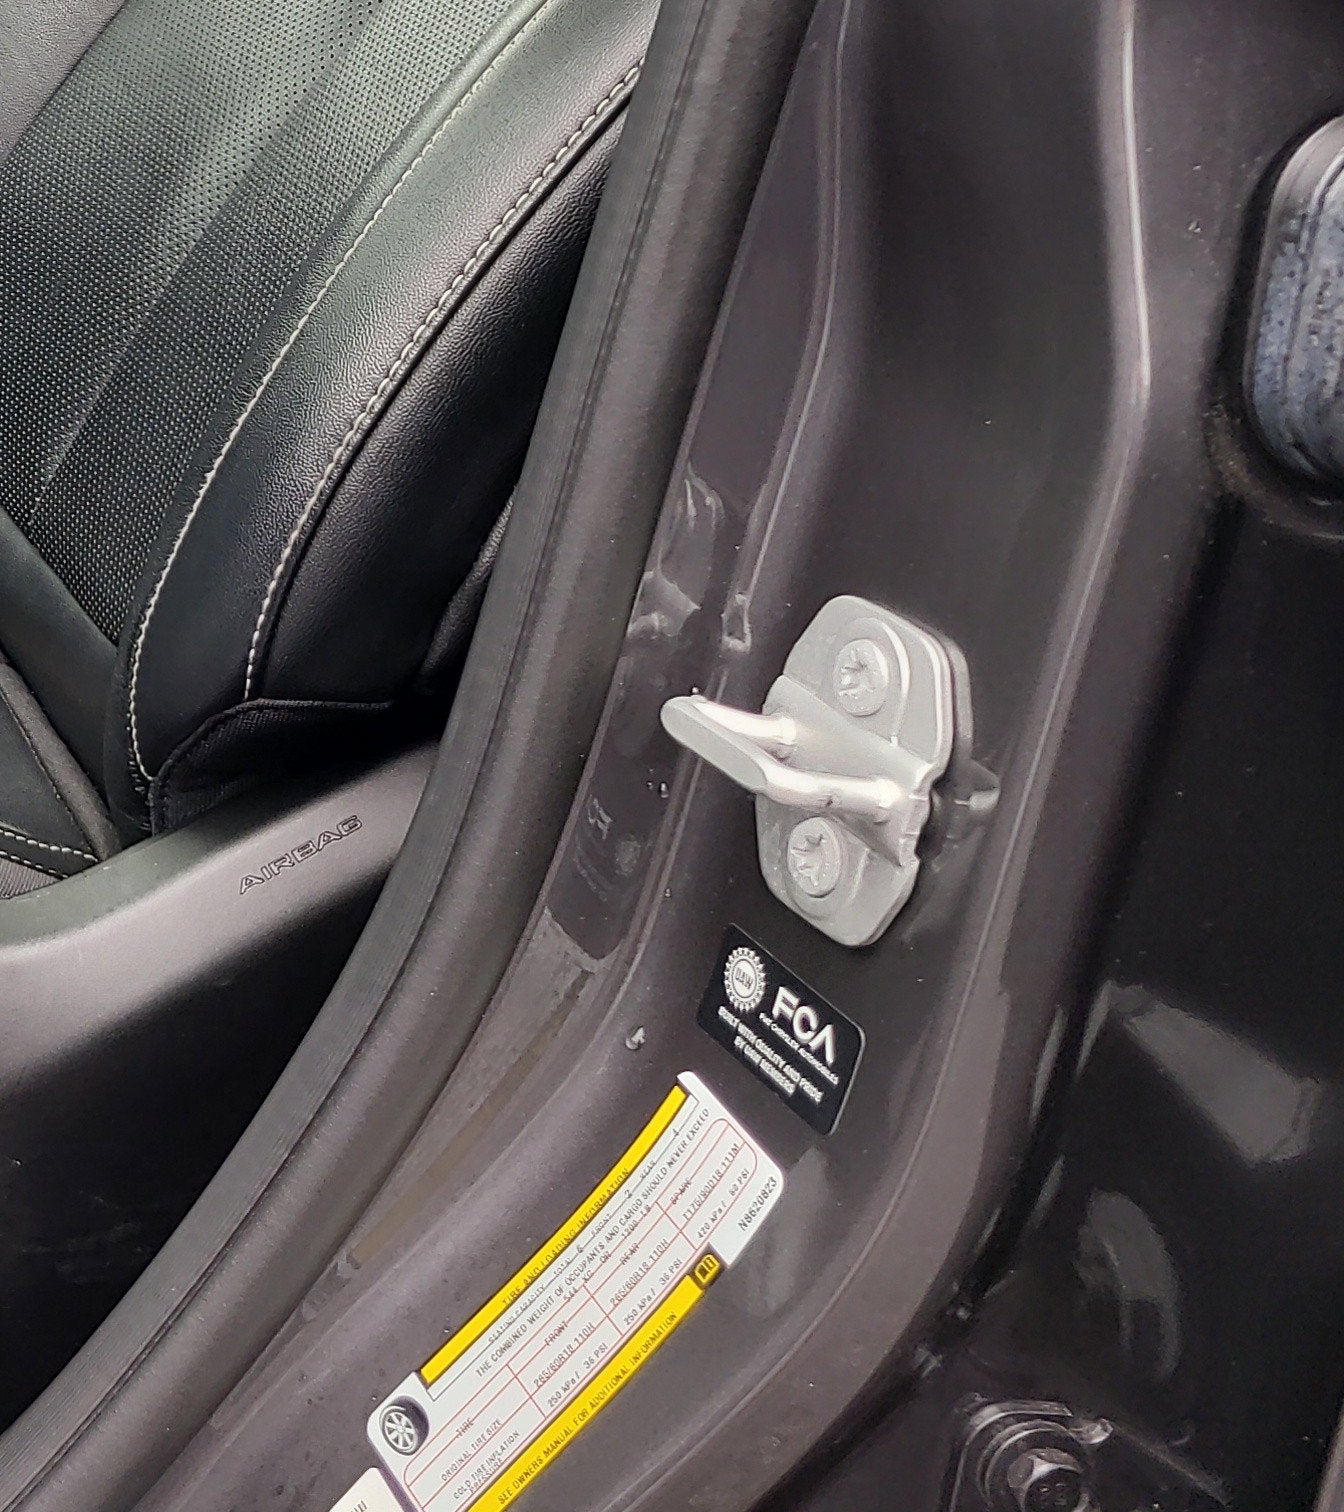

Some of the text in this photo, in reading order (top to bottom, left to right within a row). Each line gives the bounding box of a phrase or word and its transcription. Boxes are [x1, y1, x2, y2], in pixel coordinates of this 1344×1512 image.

[239, 814, 363, 895] AIRBAG
[772, 986, 836, 1066] FCA
[475, 1107, 710, 1377] THE COMBINED WEIGHT OF OCCUPANTS AND CARGO SHOULD NEVER EXCEED
[737, 1174, 778, 1232] N8620823
[453, 1478, 473, 1500] COLD
[470, 1462, 487, 1481] TIRE
[484, 1428, 520, 1467] INFLATION
[546, 1389, 563, 1408] 250
[582, 1354, 596, 1369] 36
[593, 1340, 608, 1358] PSI
[622, 1307, 639, 1326] 250
[667, 1256, 683, 1274] PSI
[695, 1220, 710, 1239] 420
[736, 1166, 750, 1185] PSI
[543, 1319, 568, 1347] FRONT
[440, 1447, 472, 1482] ORIGINAL
[470, 1431, 487, 1451] TIRE
[485, 1416, 502, 1436] SIZE
[572, 1320, 595, 1346] 110H
[496, 1310, 677, 1504] SEE OWNERS MANUAL FOR ADDITIONAL INFORMATION
